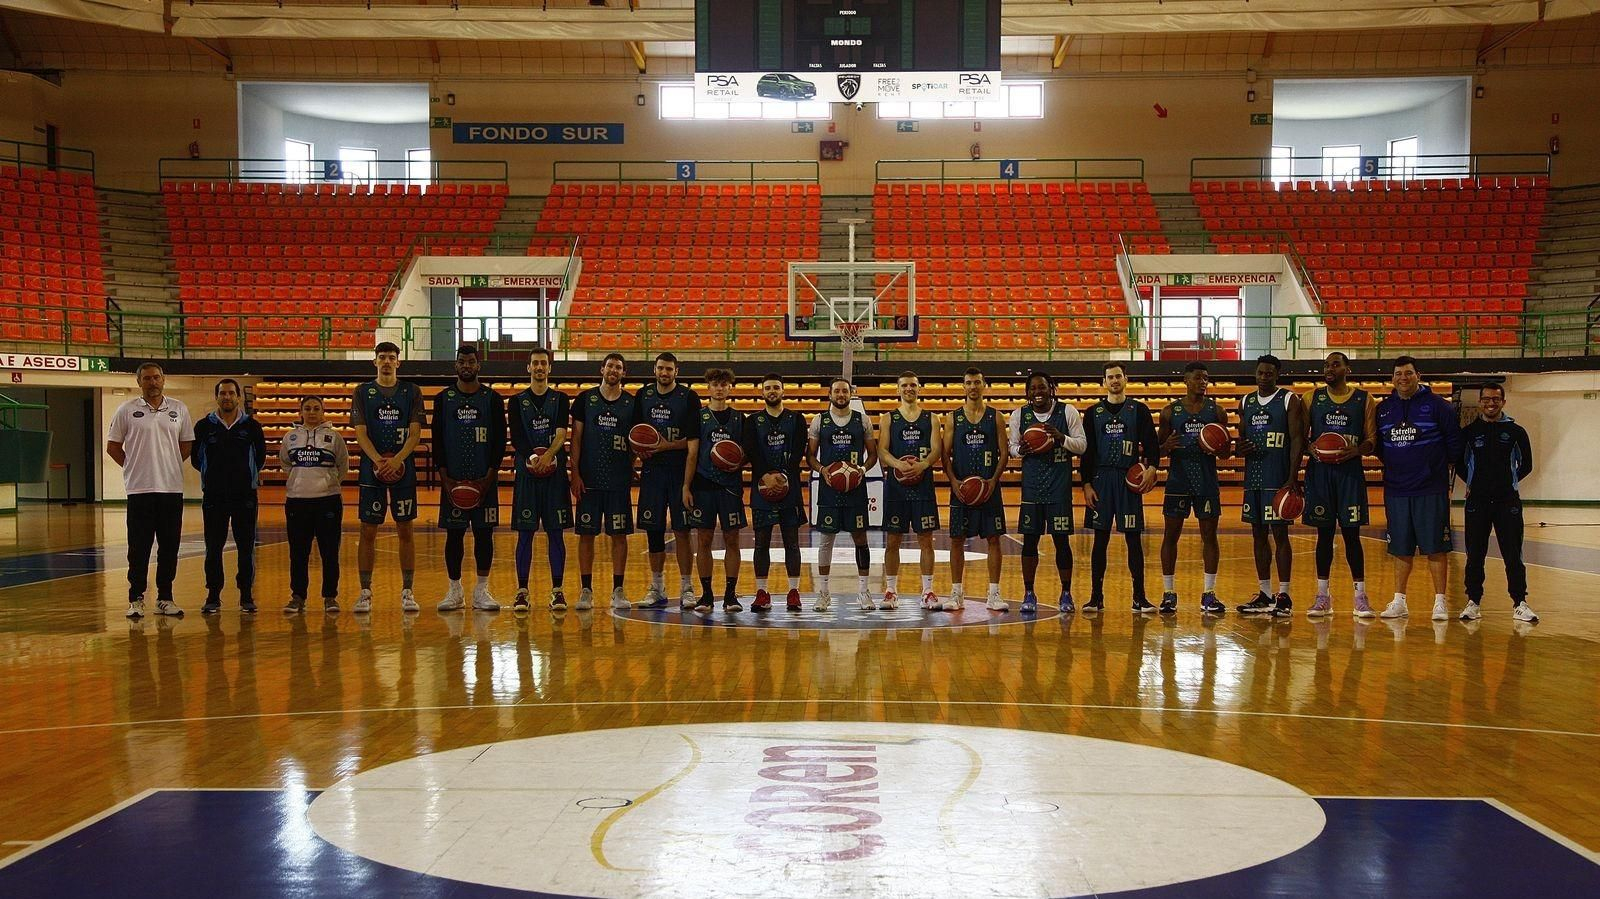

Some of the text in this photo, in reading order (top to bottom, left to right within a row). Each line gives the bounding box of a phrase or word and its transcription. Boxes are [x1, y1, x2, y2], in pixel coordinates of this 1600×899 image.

[707, 75, 739, 87] PSA
[959, 74, 991, 85] PSA
[469, 127, 608, 141] FONDO SUR
[329, 163, 339, 177] 2
[681, 164, 691, 178] 3
[1004, 163, 1015, 177] 4
[1364, 159, 1374, 173] 5
[428, 277, 460, 286] SAIDA
[503, 277, 565, 286] EMERXENCI
[1208, 274, 1277, 284] EMERXENCIA
[7, 355, 15, 366] E
[22, 356, 77, 368] ASEOS
[475, 427, 488, 443] 18
[1390, 426, 1417, 434] Estrella
[1266, 431, 1285, 449] 20
[1390, 433, 1415, 442] Galicia
[1054, 448, 1068, 463] 22
[1122, 440, 1134, 457] 10
[297, 455, 319, 463] Galicia
[850, 451, 859, 465] 8
[984, 451, 993, 467] 6
[396, 499, 413, 517] 37
[1204, 499, 1212, 514] 4
[484, 507, 497, 523] 18
[728, 512, 741, 526] 51
[856, 515, 864, 529] 8
[921, 515, 936, 529] 25
[1124, 514, 1136, 528] 10
[1053, 516, 1069, 531] 22
